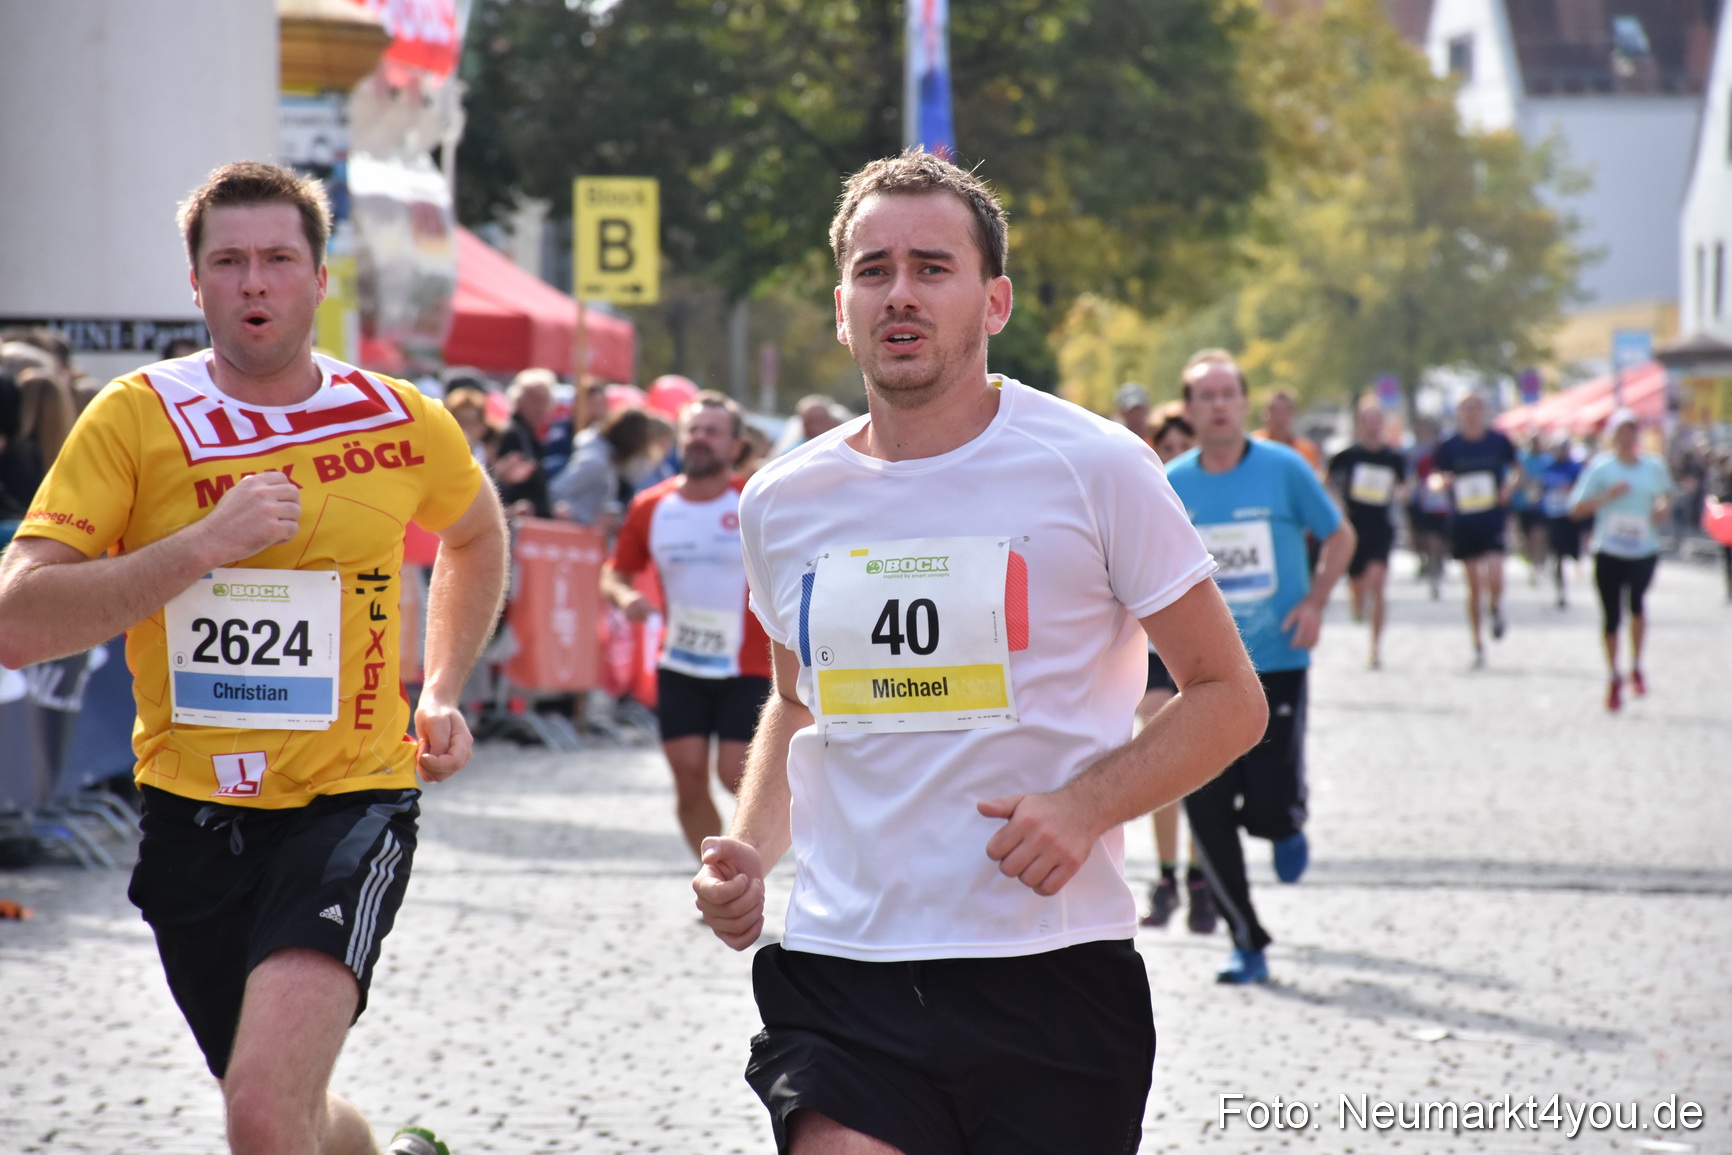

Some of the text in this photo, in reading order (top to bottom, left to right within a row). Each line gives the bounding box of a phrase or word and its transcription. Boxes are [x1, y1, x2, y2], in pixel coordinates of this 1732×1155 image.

[598, 218, 635, 273] B
[312, 440, 425, 484] BÖGL
[884, 556, 949, 573] BOCK
[230, 584, 290, 598] BOCK
[871, 598, 940, 656] 40
[191, 618, 313, 667] 2624
[177, 655, 183, 665] D
[213, 682, 288, 701] Christian
[872, 677, 949, 699] Michael
